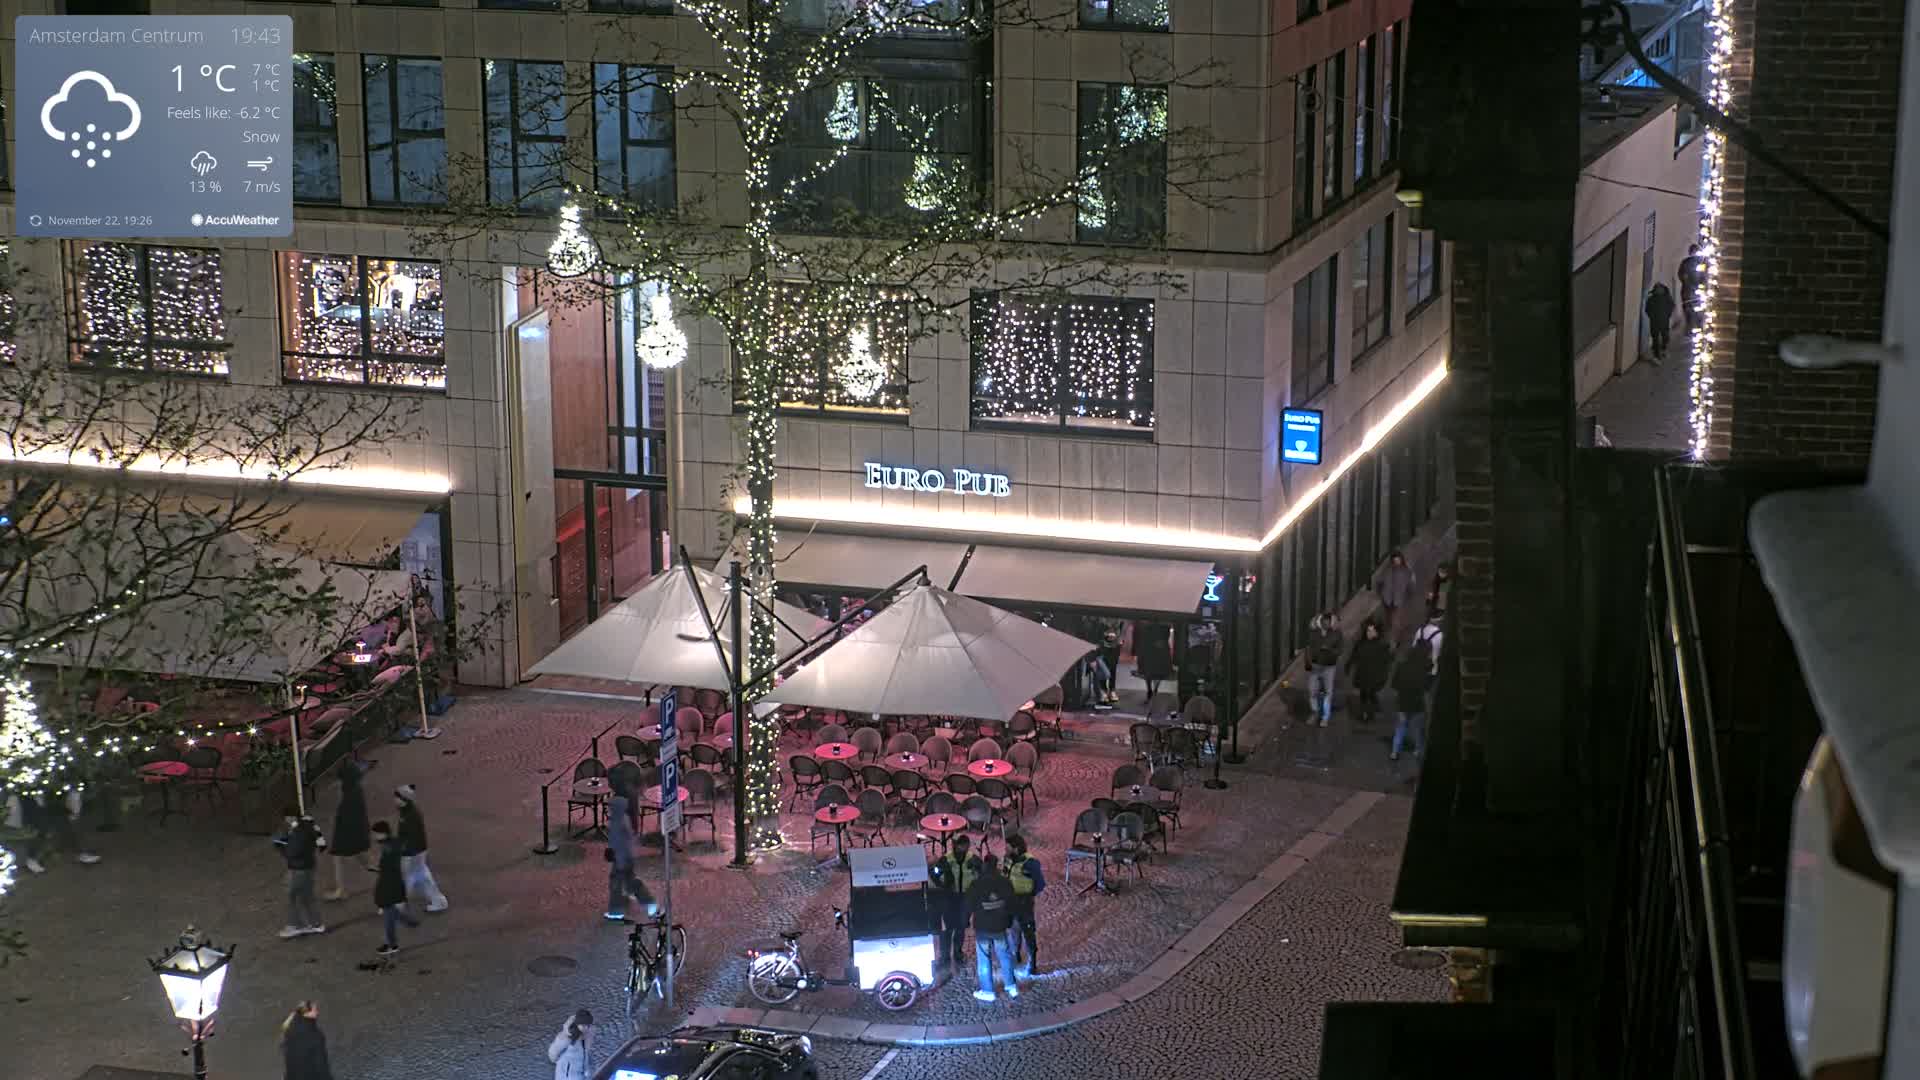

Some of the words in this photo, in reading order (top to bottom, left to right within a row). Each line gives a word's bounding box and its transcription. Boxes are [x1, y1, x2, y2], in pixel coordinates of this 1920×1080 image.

[864, 462, 945, 492] EURO
[953, 468, 1011, 497] PUB
[664, 697, 674, 723] P
[665, 762, 675, 788] P
